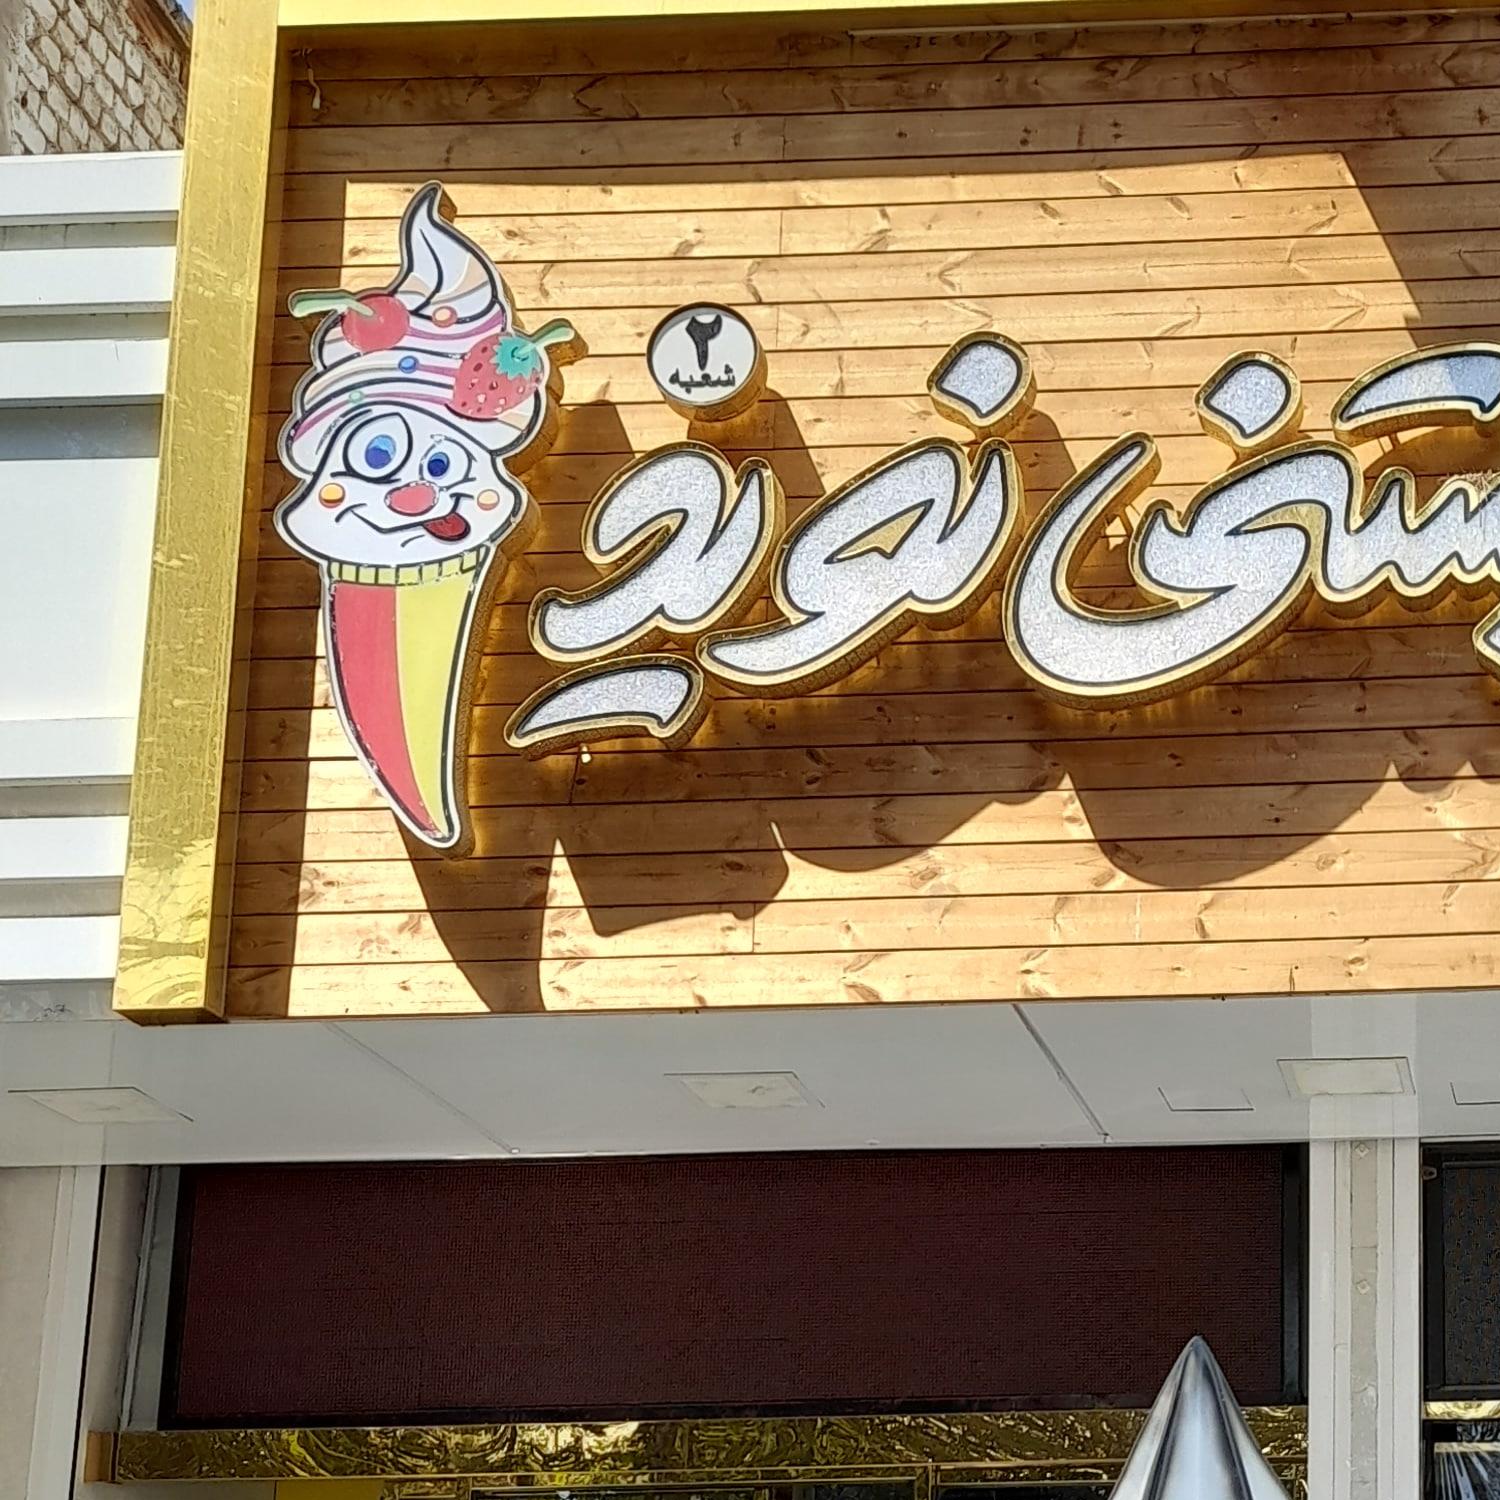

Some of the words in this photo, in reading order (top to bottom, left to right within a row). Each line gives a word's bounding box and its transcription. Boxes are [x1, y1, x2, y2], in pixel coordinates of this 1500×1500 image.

[685, 314, 723, 371] ۲
[668, 364, 736, 394] شعبه
[504, 331, 1032, 748] نوید
